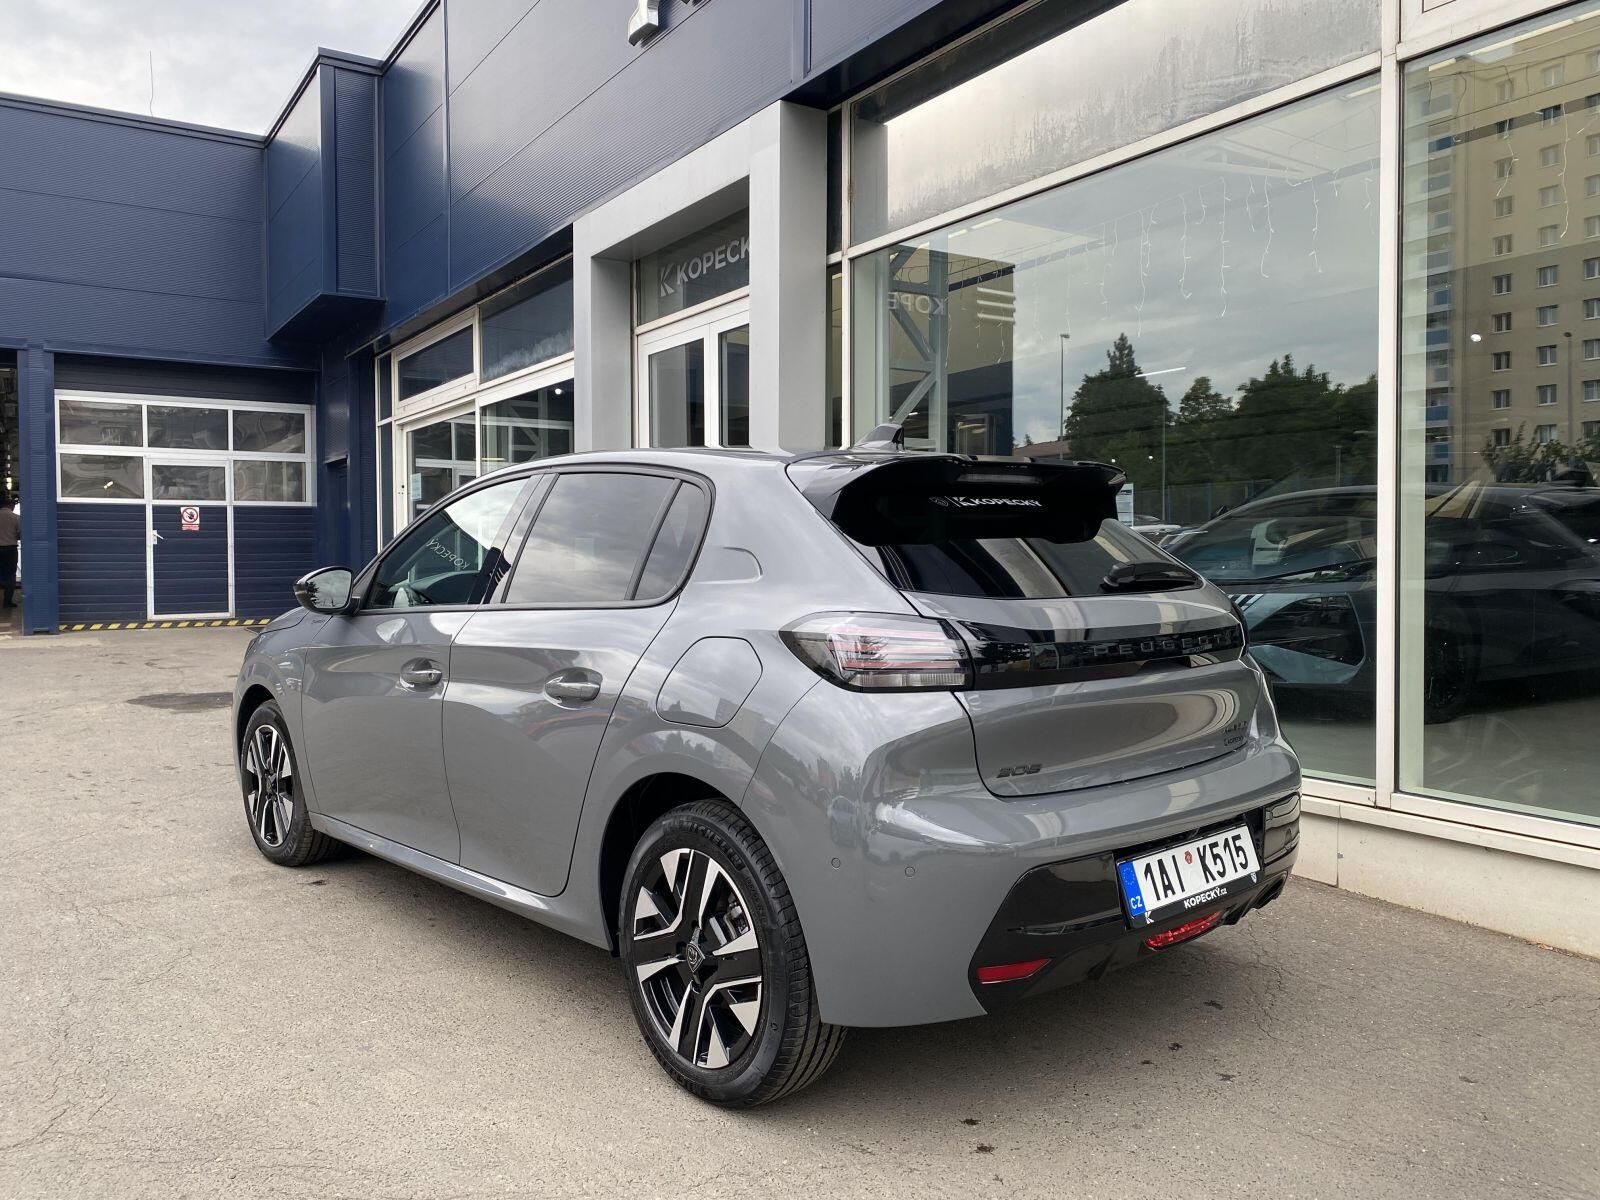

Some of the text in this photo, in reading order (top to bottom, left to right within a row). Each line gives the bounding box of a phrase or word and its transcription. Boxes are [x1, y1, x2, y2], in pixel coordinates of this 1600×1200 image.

[1143, 833, 1249, 901] 1AI K515
[1130, 896, 1143, 910] CZ
